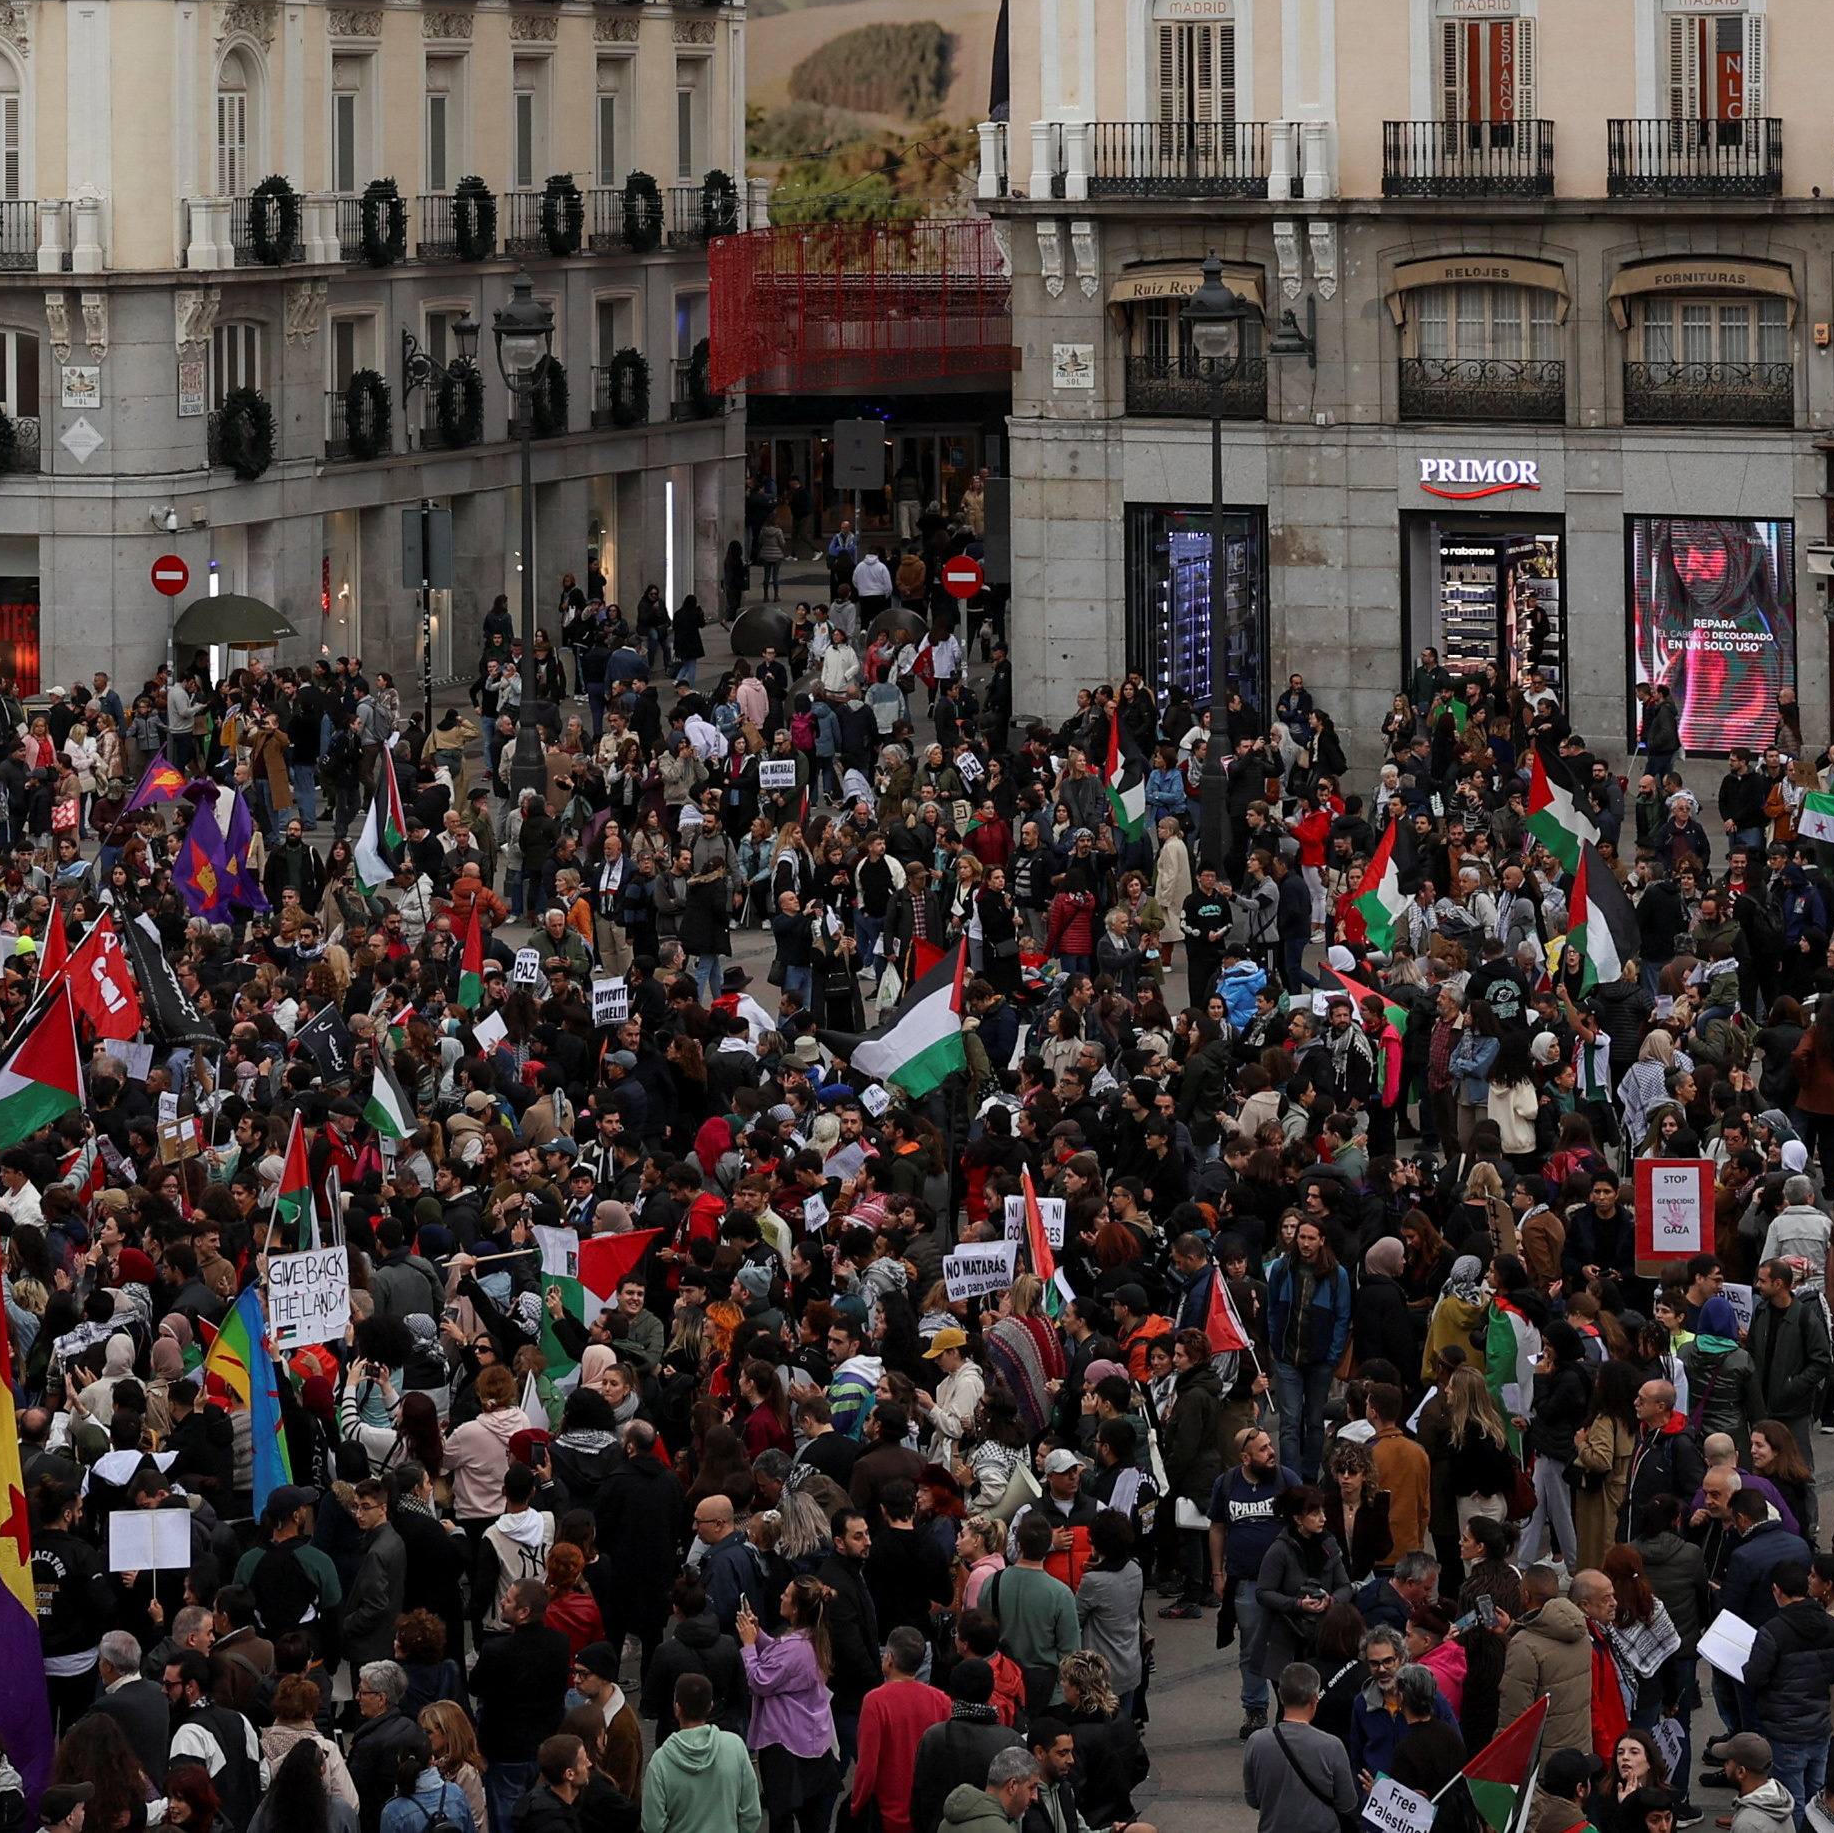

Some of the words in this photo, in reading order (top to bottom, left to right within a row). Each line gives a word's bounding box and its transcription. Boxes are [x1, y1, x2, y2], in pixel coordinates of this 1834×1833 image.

[1170, 2, 1227, 14] MADRID
[1726, 56, 1742, 120] NLC
[1445, 267, 1509, 279] RELOJES
[1655, 273, 1746, 285] FORNITURAS
[1133, 282, 1163, 297] Ruiz
[1066, 378, 1081, 386] SOL
[1420, 457, 1540, 484] PRIMOR
[1449, 546, 1496, 557] rabanne
[1693, 618, 1737, 630] REPARA
[1657, 630, 1667, 638] EL
[1670, 630, 1710, 639] CABELLO
[1712, 631, 1773, 641] DECOLORADO
[1668, 640, 1683, 650] EN
[1685, 640, 1701, 651] UN
[1704, 641, 1733, 651] SOLO
[760, 764, 768, 774] NO
[962, 760, 982, 779] PAZ
[518, 951, 538, 959] JUSTA
[515, 961, 537, 980] PAZ
[595, 987, 626, 1005] BOYCOTT
[1663, 1174, 1687, 1184] STOP
[1656, 1196, 1694, 1205] GENOCIDIO
[1007, 1203, 1017, 1217] NI
[1052, 1204, 1062, 1219] NI
[1663, 1225, 1689, 1234] GAZA
[268, 1259, 303, 1287] GIVE
[306, 1251, 341, 1283] BACK
[946, 1260, 960, 1278] NO
[962, 1257, 1006, 1275] MATARÁS
[950, 1284, 966, 1297] vale
[968, 1281, 984, 1295] para
[984, 1276, 1010, 1290] todos!
[269, 1295, 300, 1321] THE
[50, 1553, 66, 1579] FOR
[1388, 1786, 1417, 1813] Free
